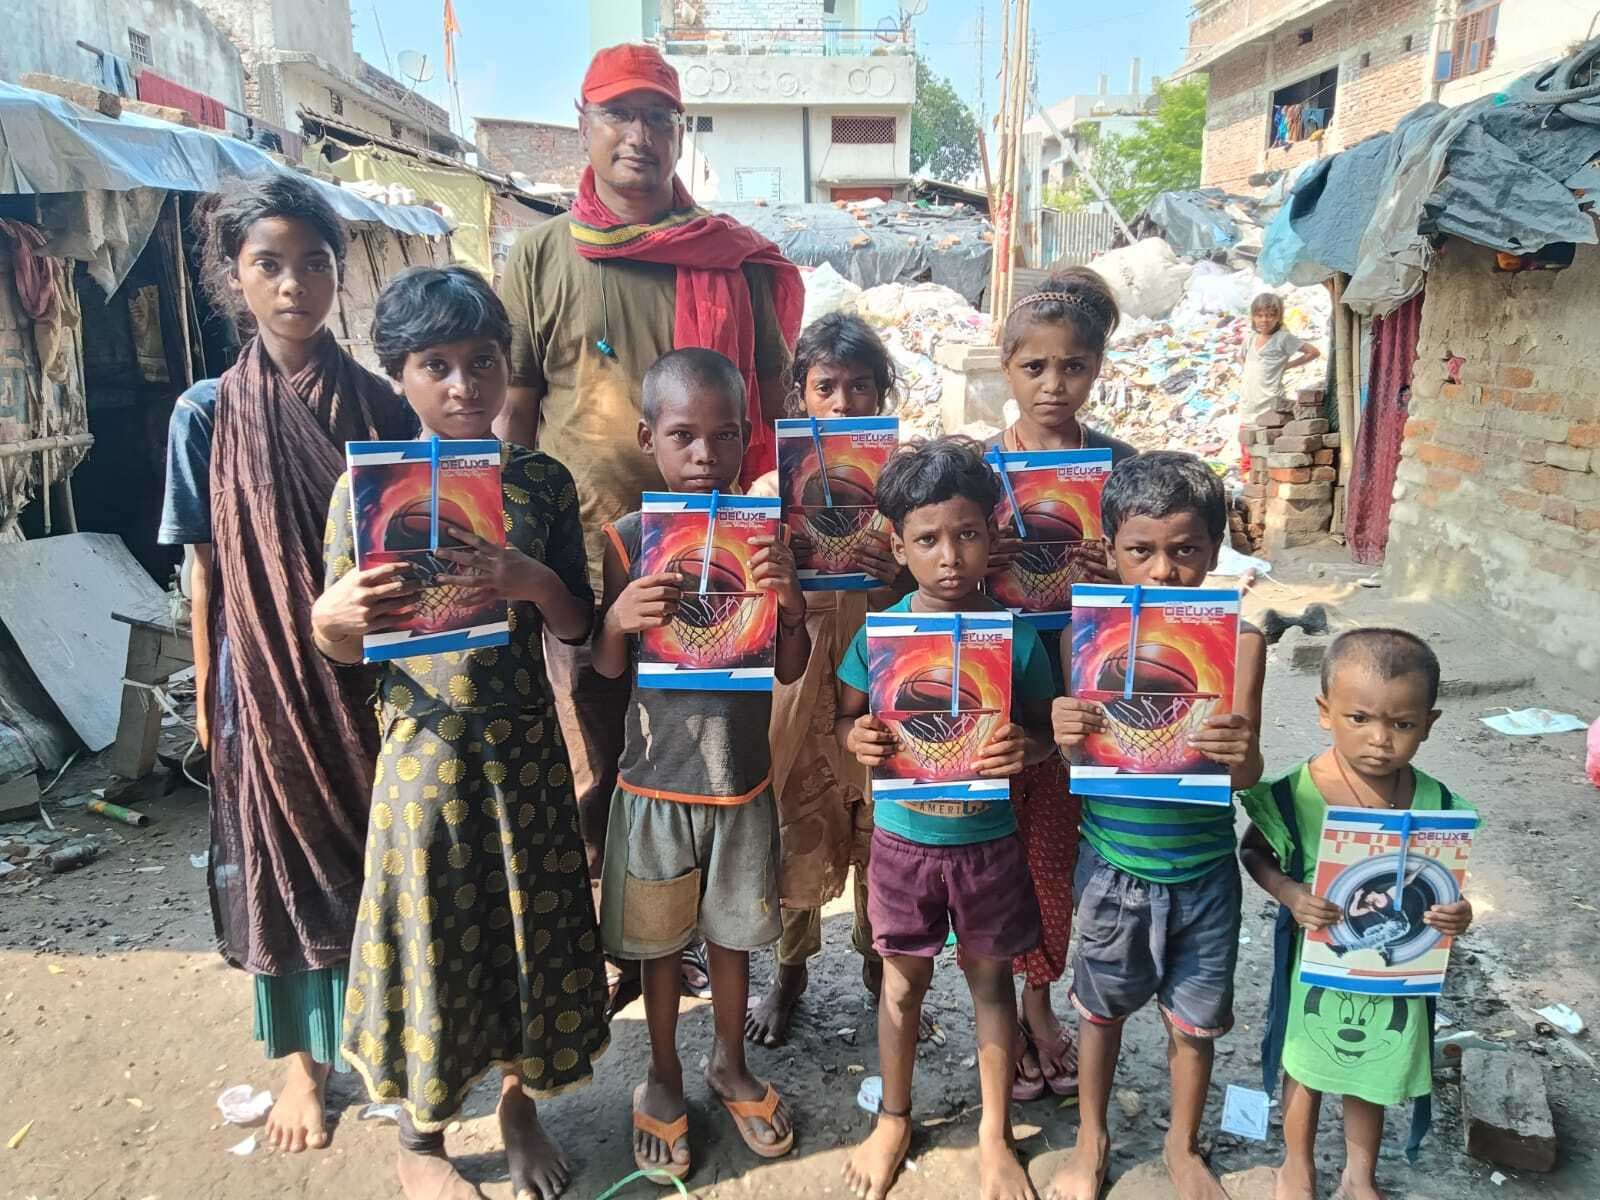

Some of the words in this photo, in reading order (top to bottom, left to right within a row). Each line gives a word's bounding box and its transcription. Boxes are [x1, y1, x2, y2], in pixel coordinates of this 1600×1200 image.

[851, 432, 894, 442] DELUXE
[440, 459, 489, 469] DELUXE
[1058, 465, 1103, 475] DELUXE
[719, 510, 767, 522] DELUXE
[1164, 605, 1225, 616] DELUXE
[960, 632, 1003, 642] ELUXE
[1417, 832, 1470, 841] DELUXE
